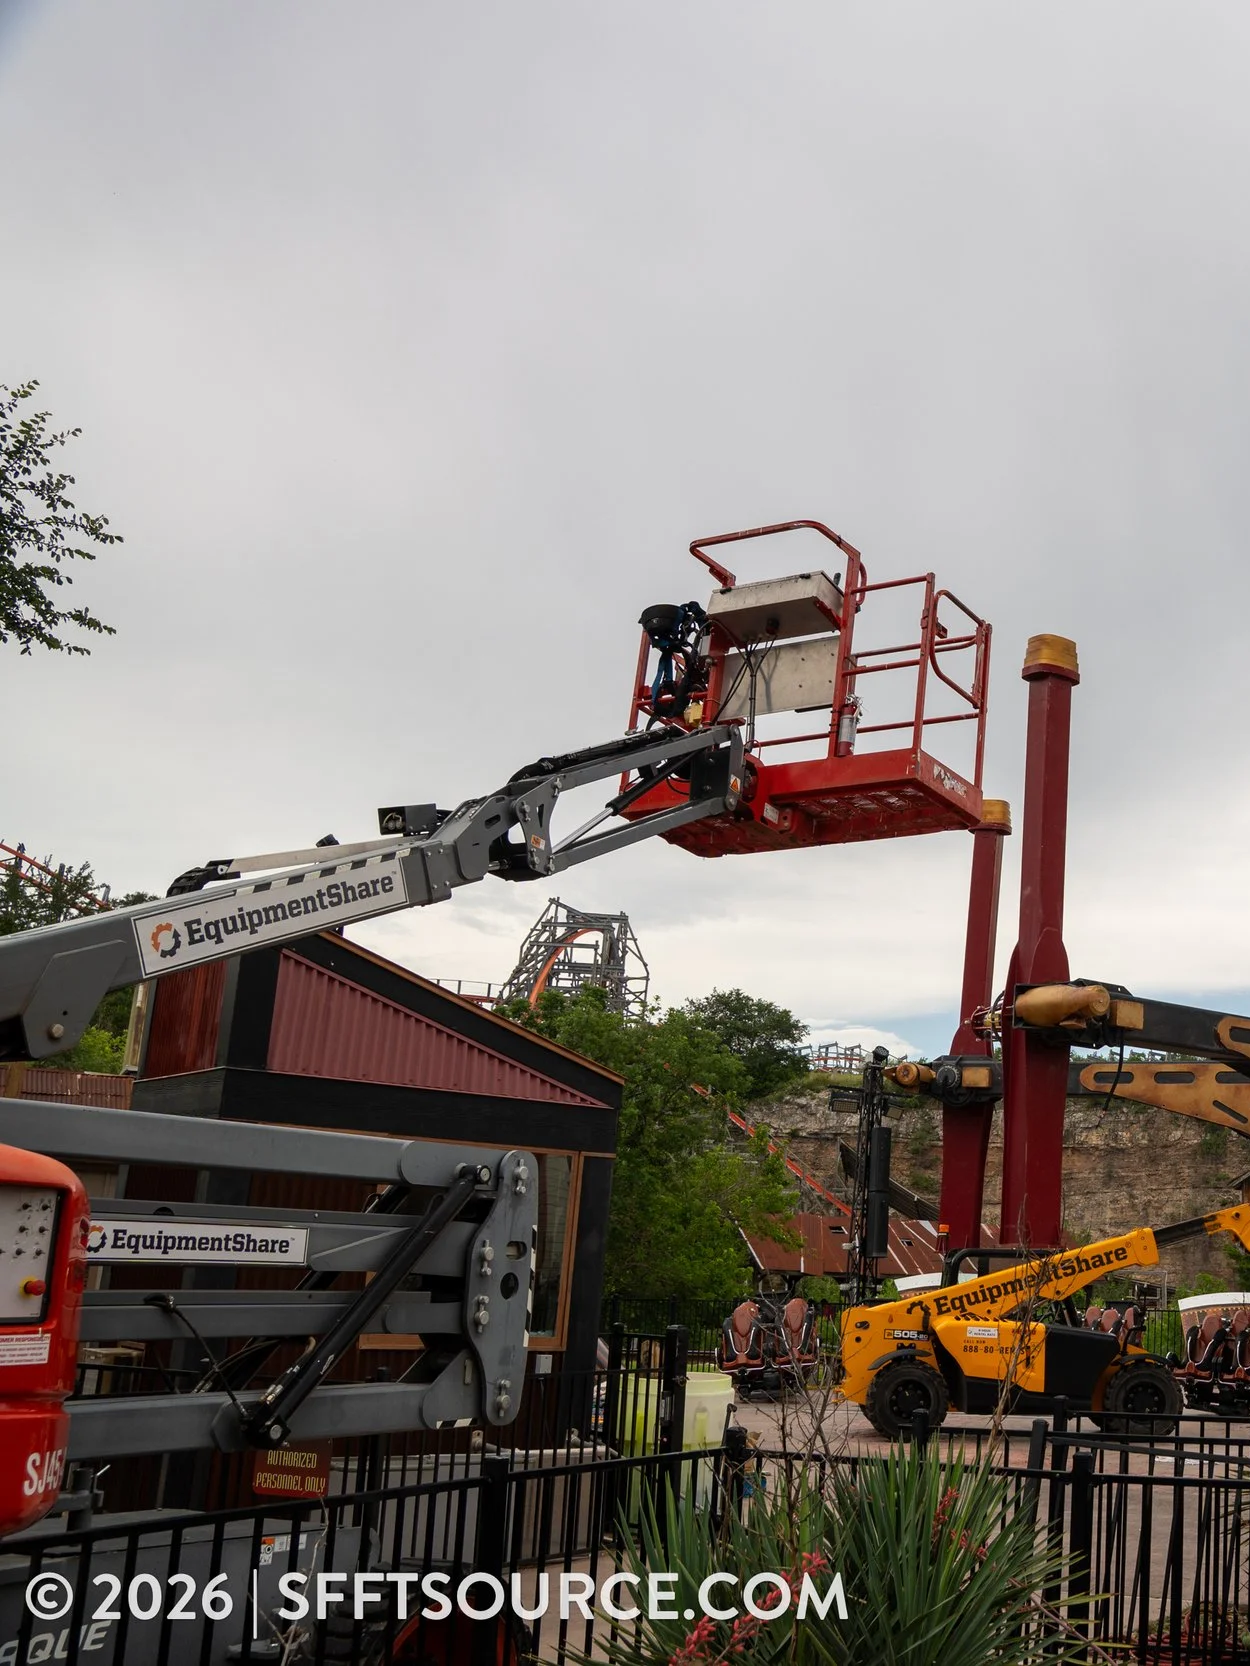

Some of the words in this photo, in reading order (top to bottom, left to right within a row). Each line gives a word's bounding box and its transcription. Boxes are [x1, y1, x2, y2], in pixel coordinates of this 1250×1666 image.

[184, 874, 394, 946] EquipmentShare
[111, 1229, 290, 1255] EquipmentShare
[267, 1450, 317, 1468] AUTHORIZED
[255, 1472, 302, 1491] PERSONNEL
[304, 1476, 326, 1493] ONLY
